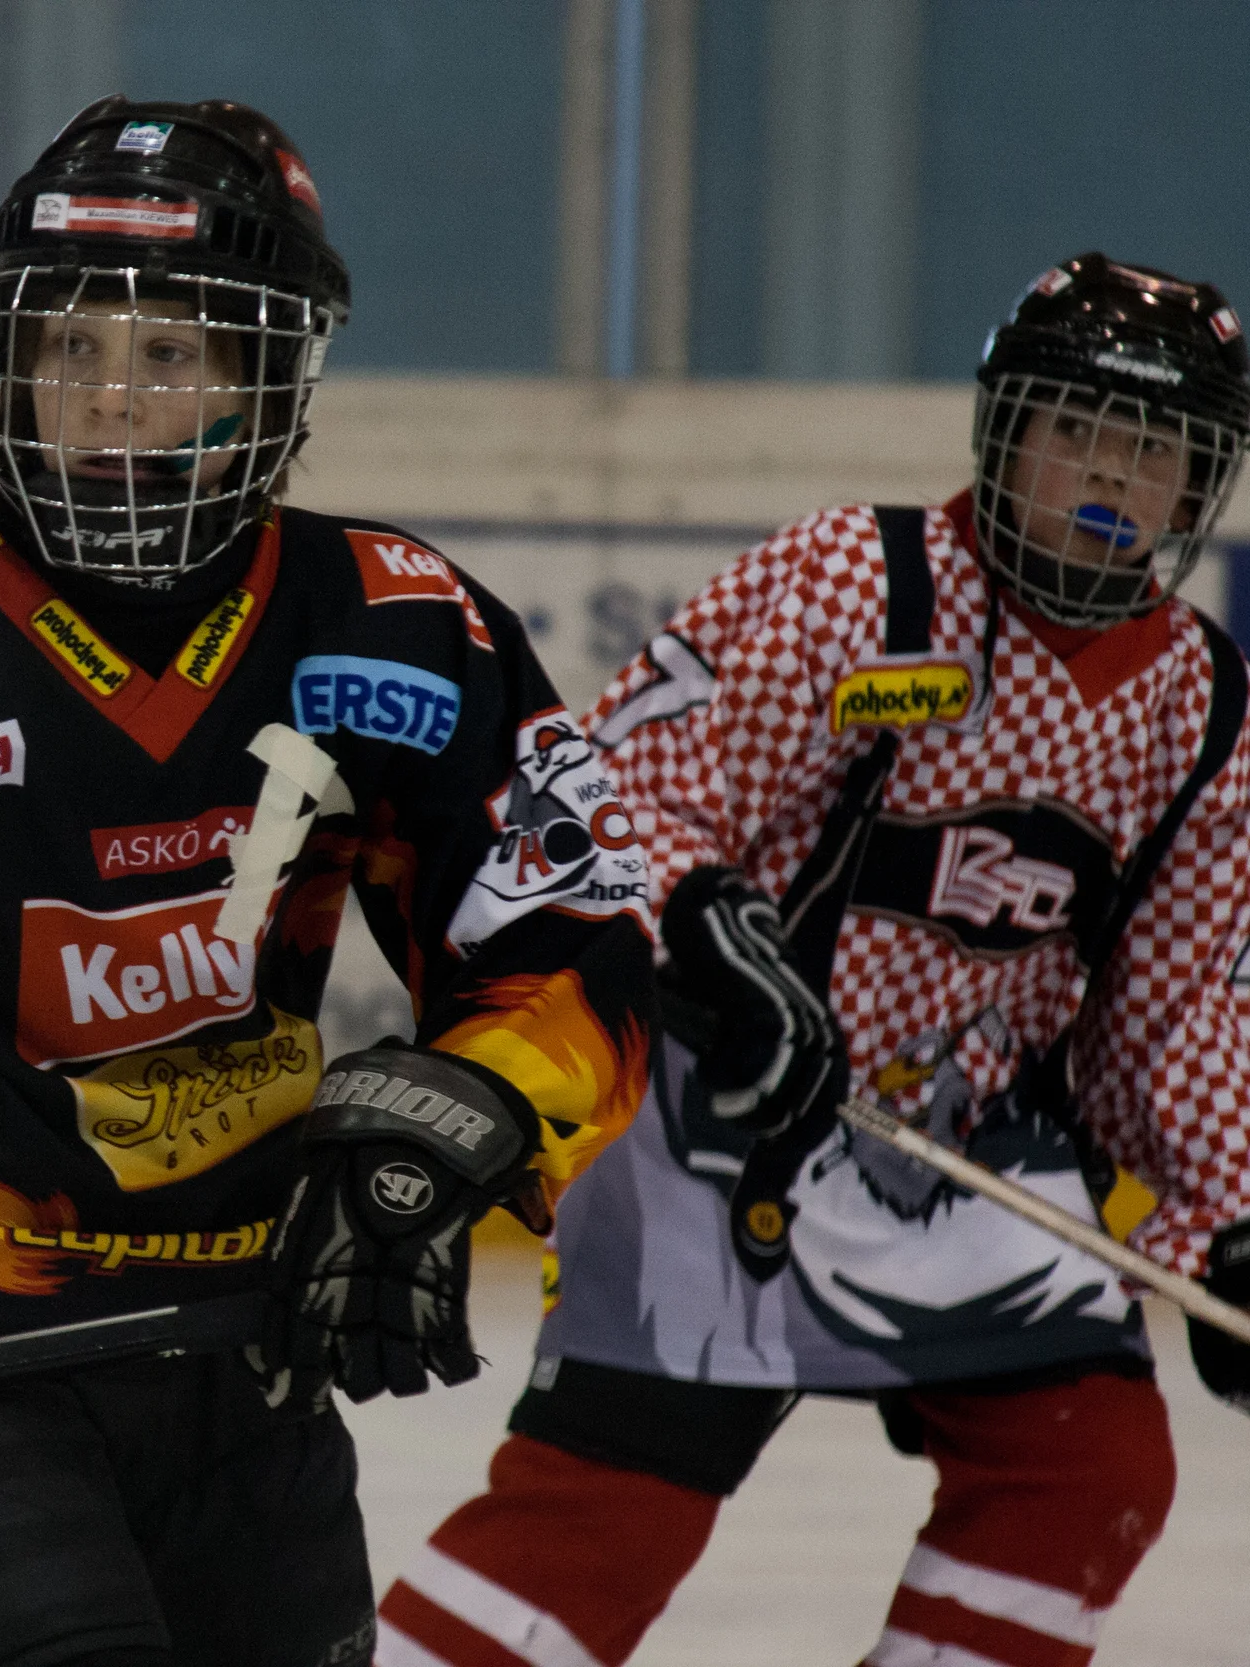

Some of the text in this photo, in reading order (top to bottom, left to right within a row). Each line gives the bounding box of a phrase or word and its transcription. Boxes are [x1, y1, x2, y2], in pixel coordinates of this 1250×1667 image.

[34, 607, 126, 690] prohockey.at
[300, 673, 458, 751] ERSTE
[105, 823, 200, 869] ASKÖ
